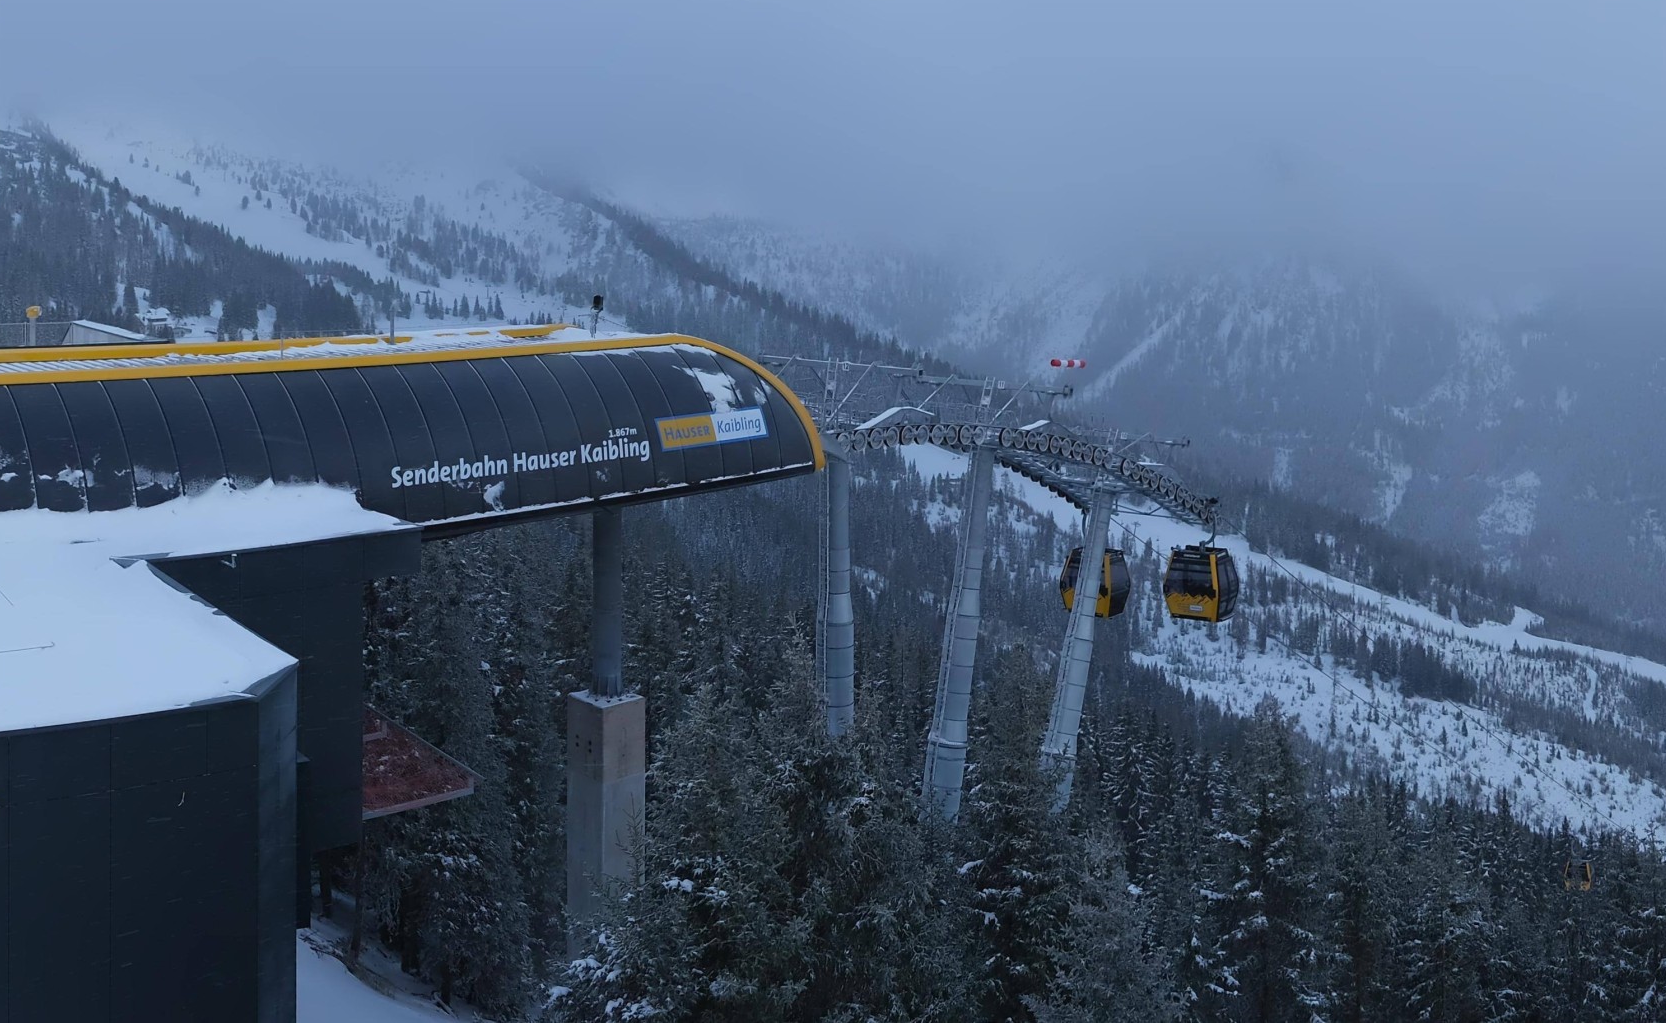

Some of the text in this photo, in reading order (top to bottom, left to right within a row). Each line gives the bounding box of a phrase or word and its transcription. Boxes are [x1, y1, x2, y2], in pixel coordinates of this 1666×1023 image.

[608, 427, 638, 438] 1.867m
[716, 416, 761, 433] Kaibling
[391, 437, 651, 489] Senderbahn Hauser Kaibling
